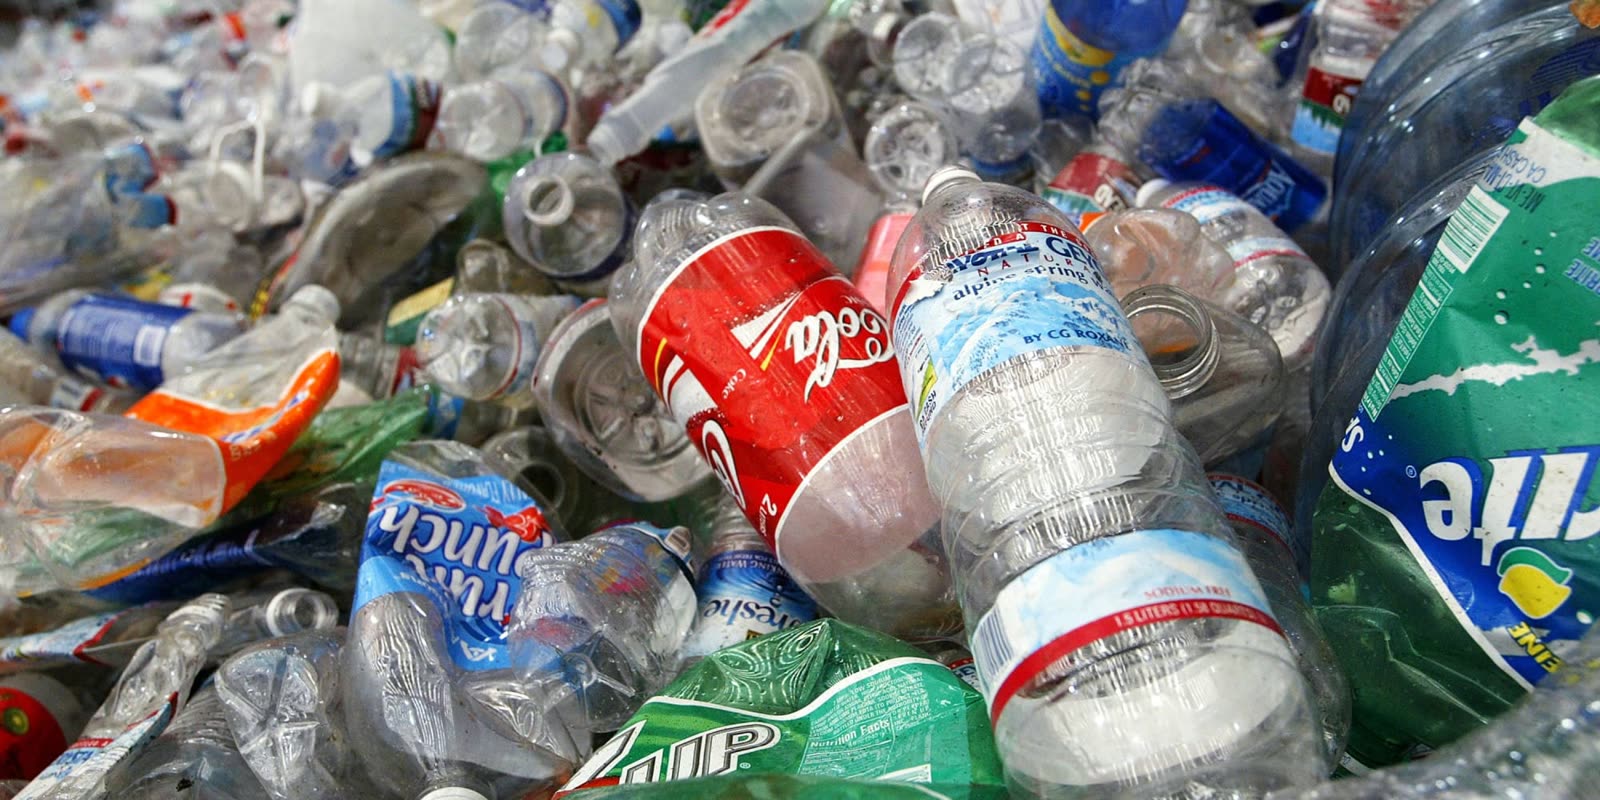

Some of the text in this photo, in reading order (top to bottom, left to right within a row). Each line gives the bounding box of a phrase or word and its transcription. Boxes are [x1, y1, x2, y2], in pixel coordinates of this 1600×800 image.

[953, 273, 1017, 301] alpine
[1024, 262, 1089, 285] spring
[1023, 333, 1042, 344] BY
[1047, 328, 1071, 339] CG
[785, 306, 897, 404] Cola
[722, 367, 747, 399] Coke
[704, 598, 800, 630] reshe
[1134, 603, 1180, 624] LITERS
